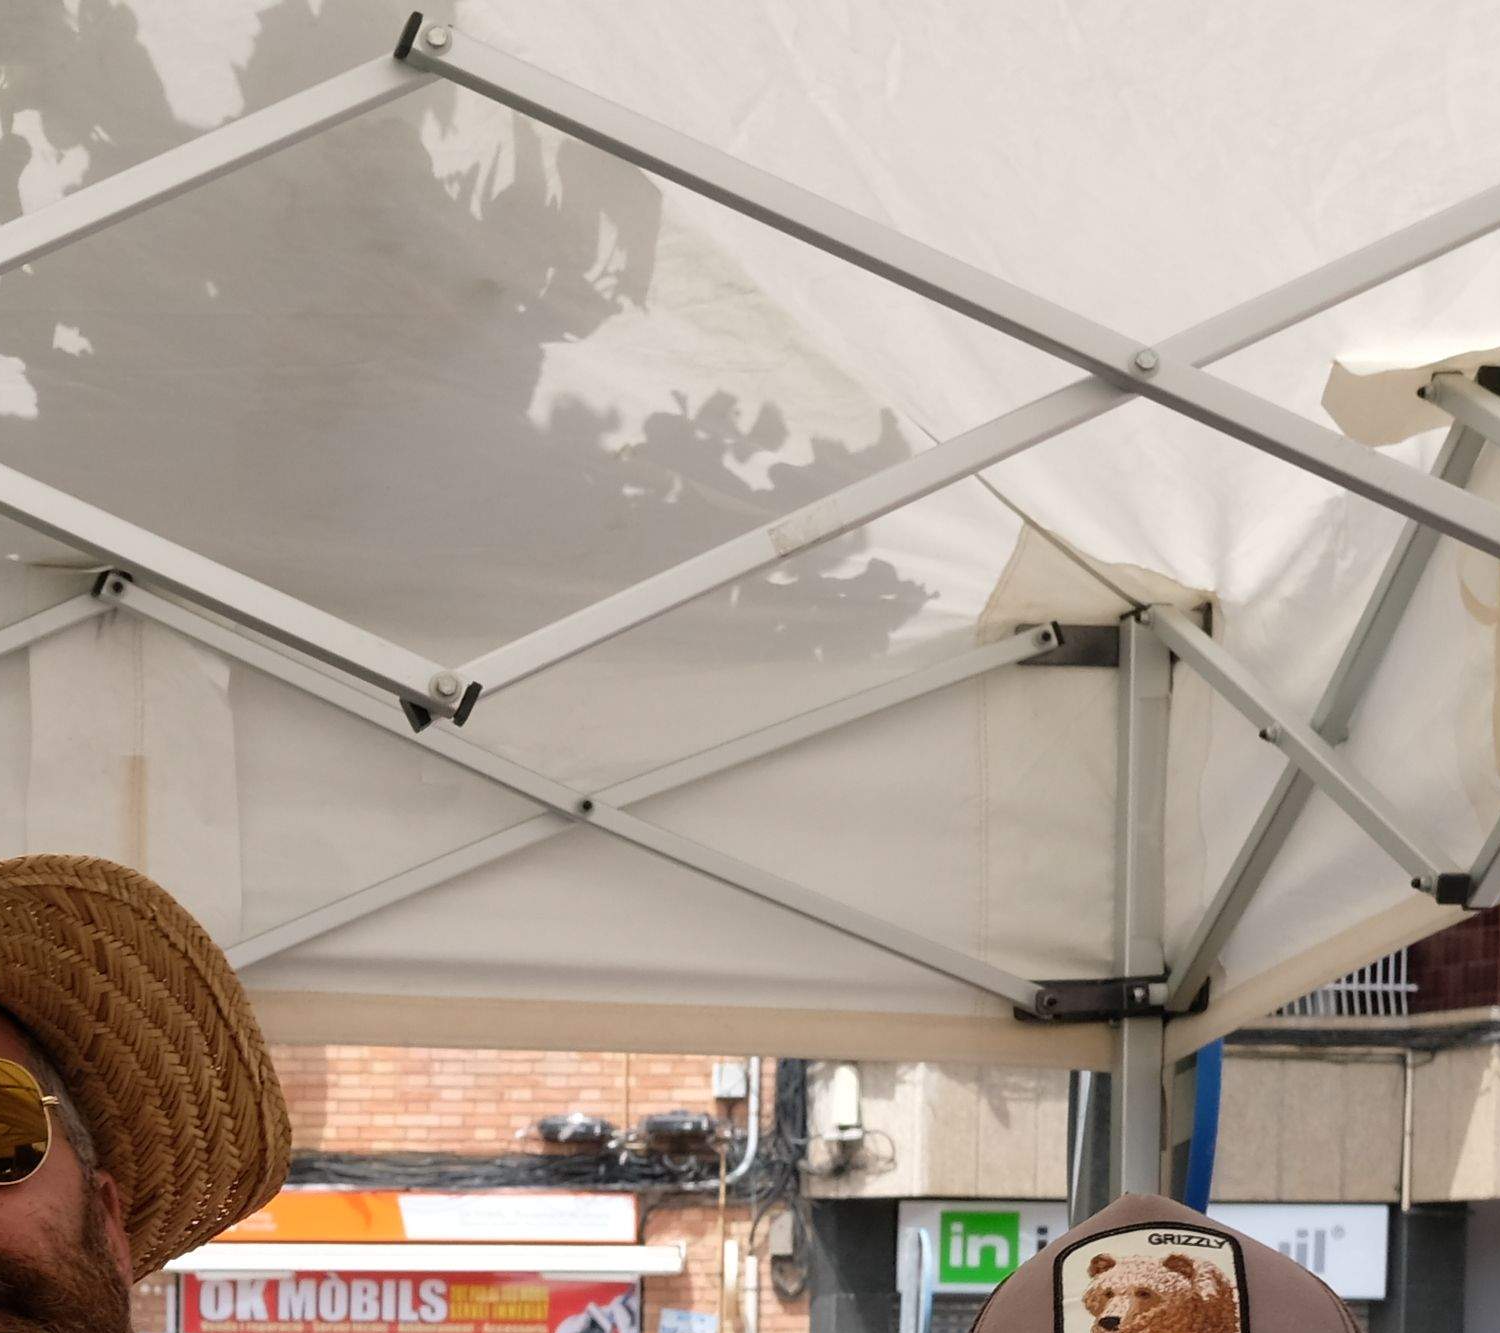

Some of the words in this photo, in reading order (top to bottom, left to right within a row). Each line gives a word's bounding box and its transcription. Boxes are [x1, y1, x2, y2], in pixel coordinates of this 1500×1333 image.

[948, 1221, 1010, 1268] in
[1148, 1232, 1229, 1249] GRIZZLY
[199, 1278, 269, 1322] OK
[277, 1271, 449, 1323] MÒBILS
